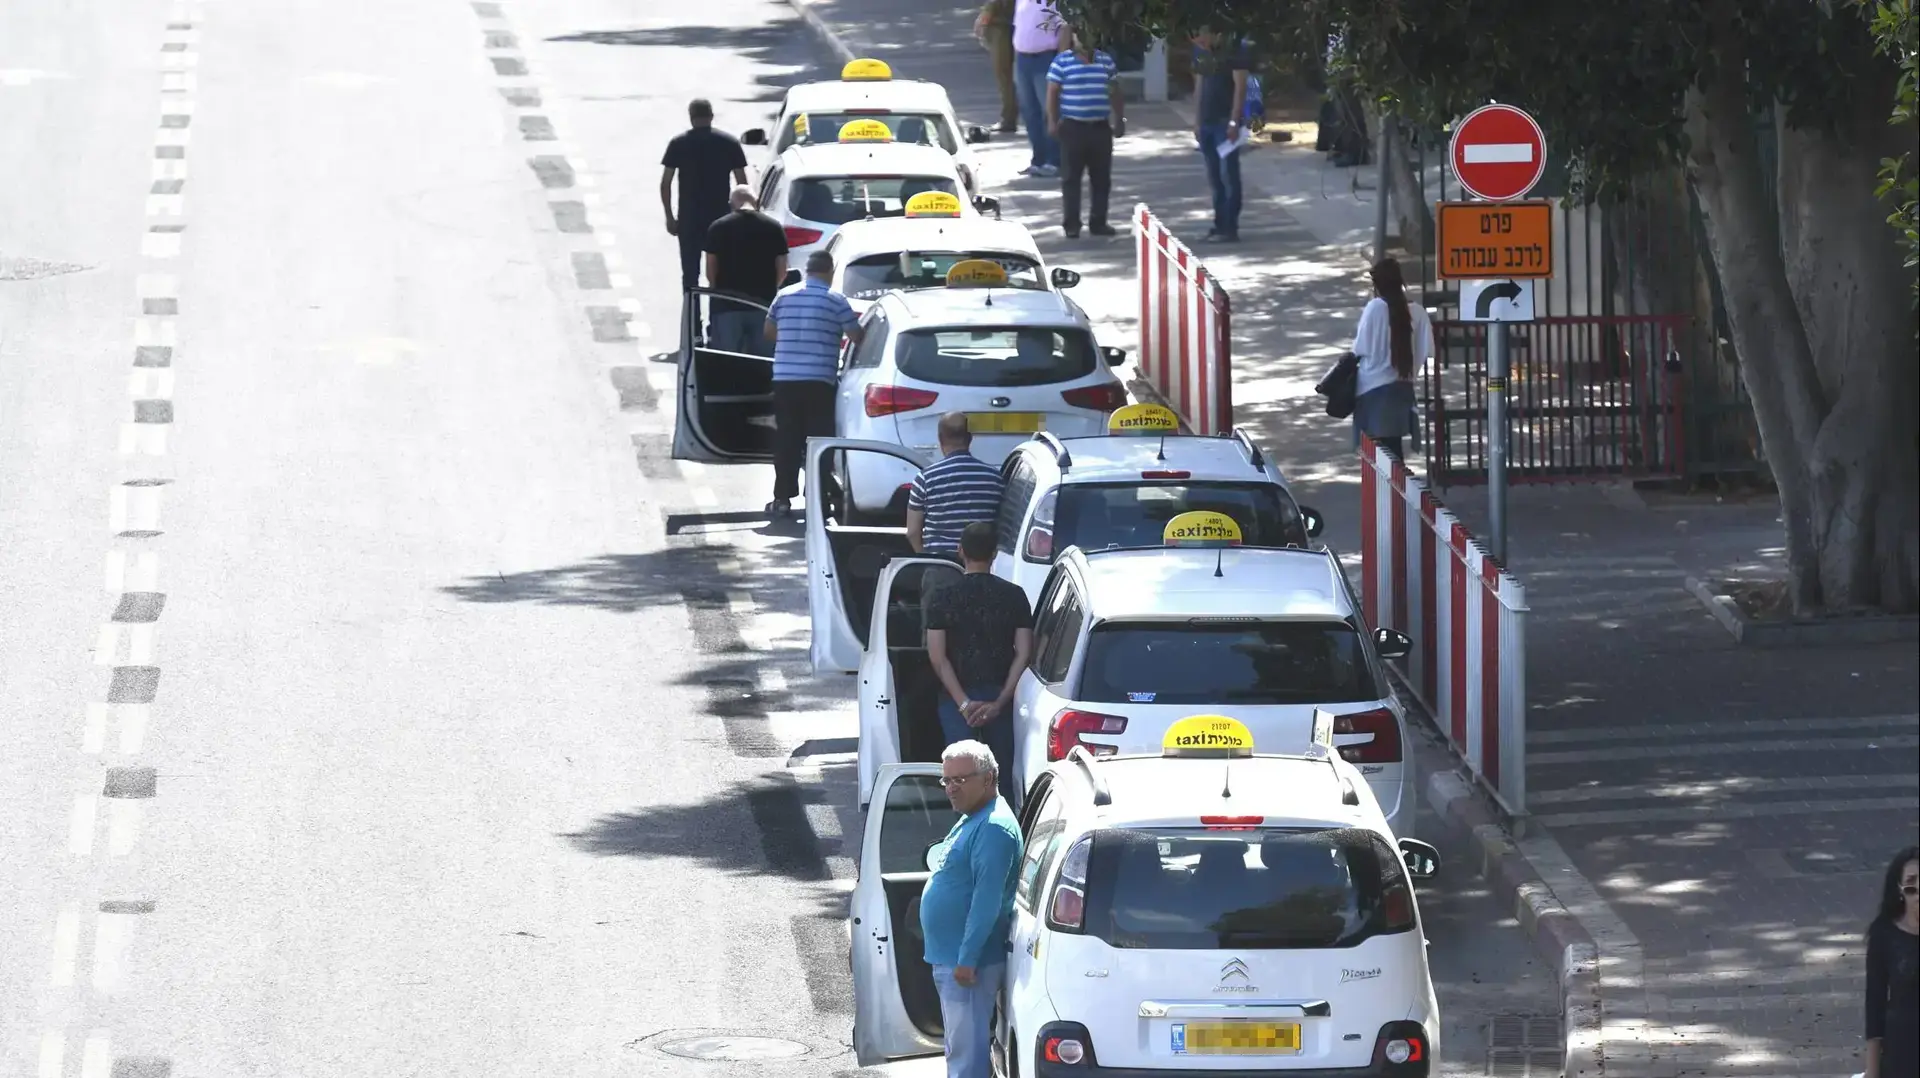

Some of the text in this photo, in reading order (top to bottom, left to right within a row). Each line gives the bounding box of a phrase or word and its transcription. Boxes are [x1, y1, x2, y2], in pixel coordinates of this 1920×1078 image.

[1481, 213, 1512, 234] פרט
[1451, 243, 1542, 268] לרכב עבודה
[1120, 414, 1143, 427] taxi
[1172, 523, 1232, 537] taxi מונית
[1176, 731, 1243, 746] taxi מונית
